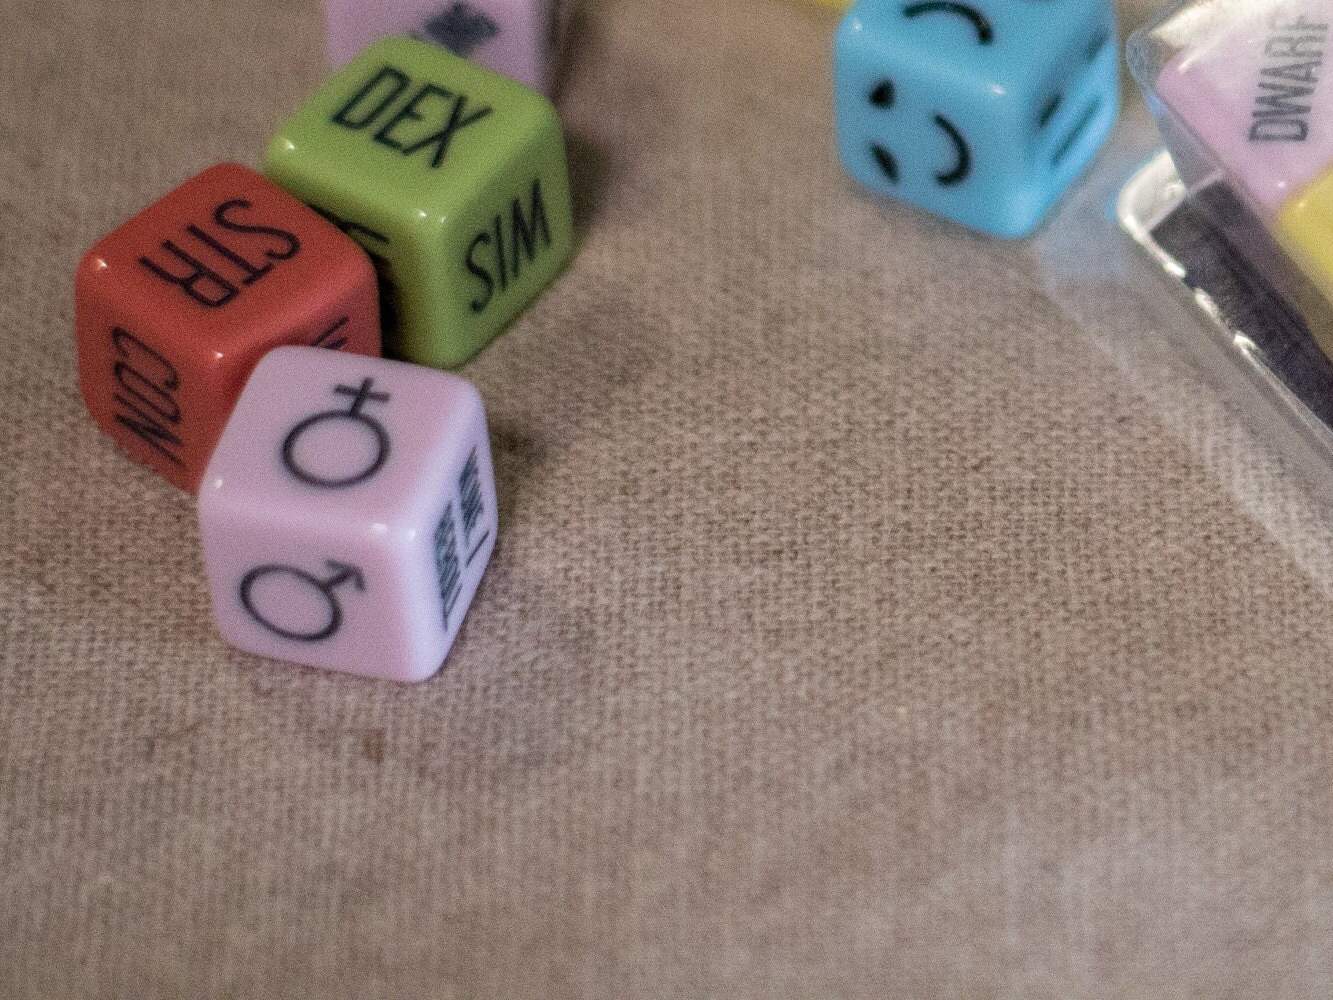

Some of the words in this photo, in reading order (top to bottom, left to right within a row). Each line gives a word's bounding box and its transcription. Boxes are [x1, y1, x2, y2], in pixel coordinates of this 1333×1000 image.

[330, 65, 493, 170] DEX
[1246, 8, 1330, 143] DWARF
[138, 198, 301, 309] STR
[109, 324, 187, 472] CON
